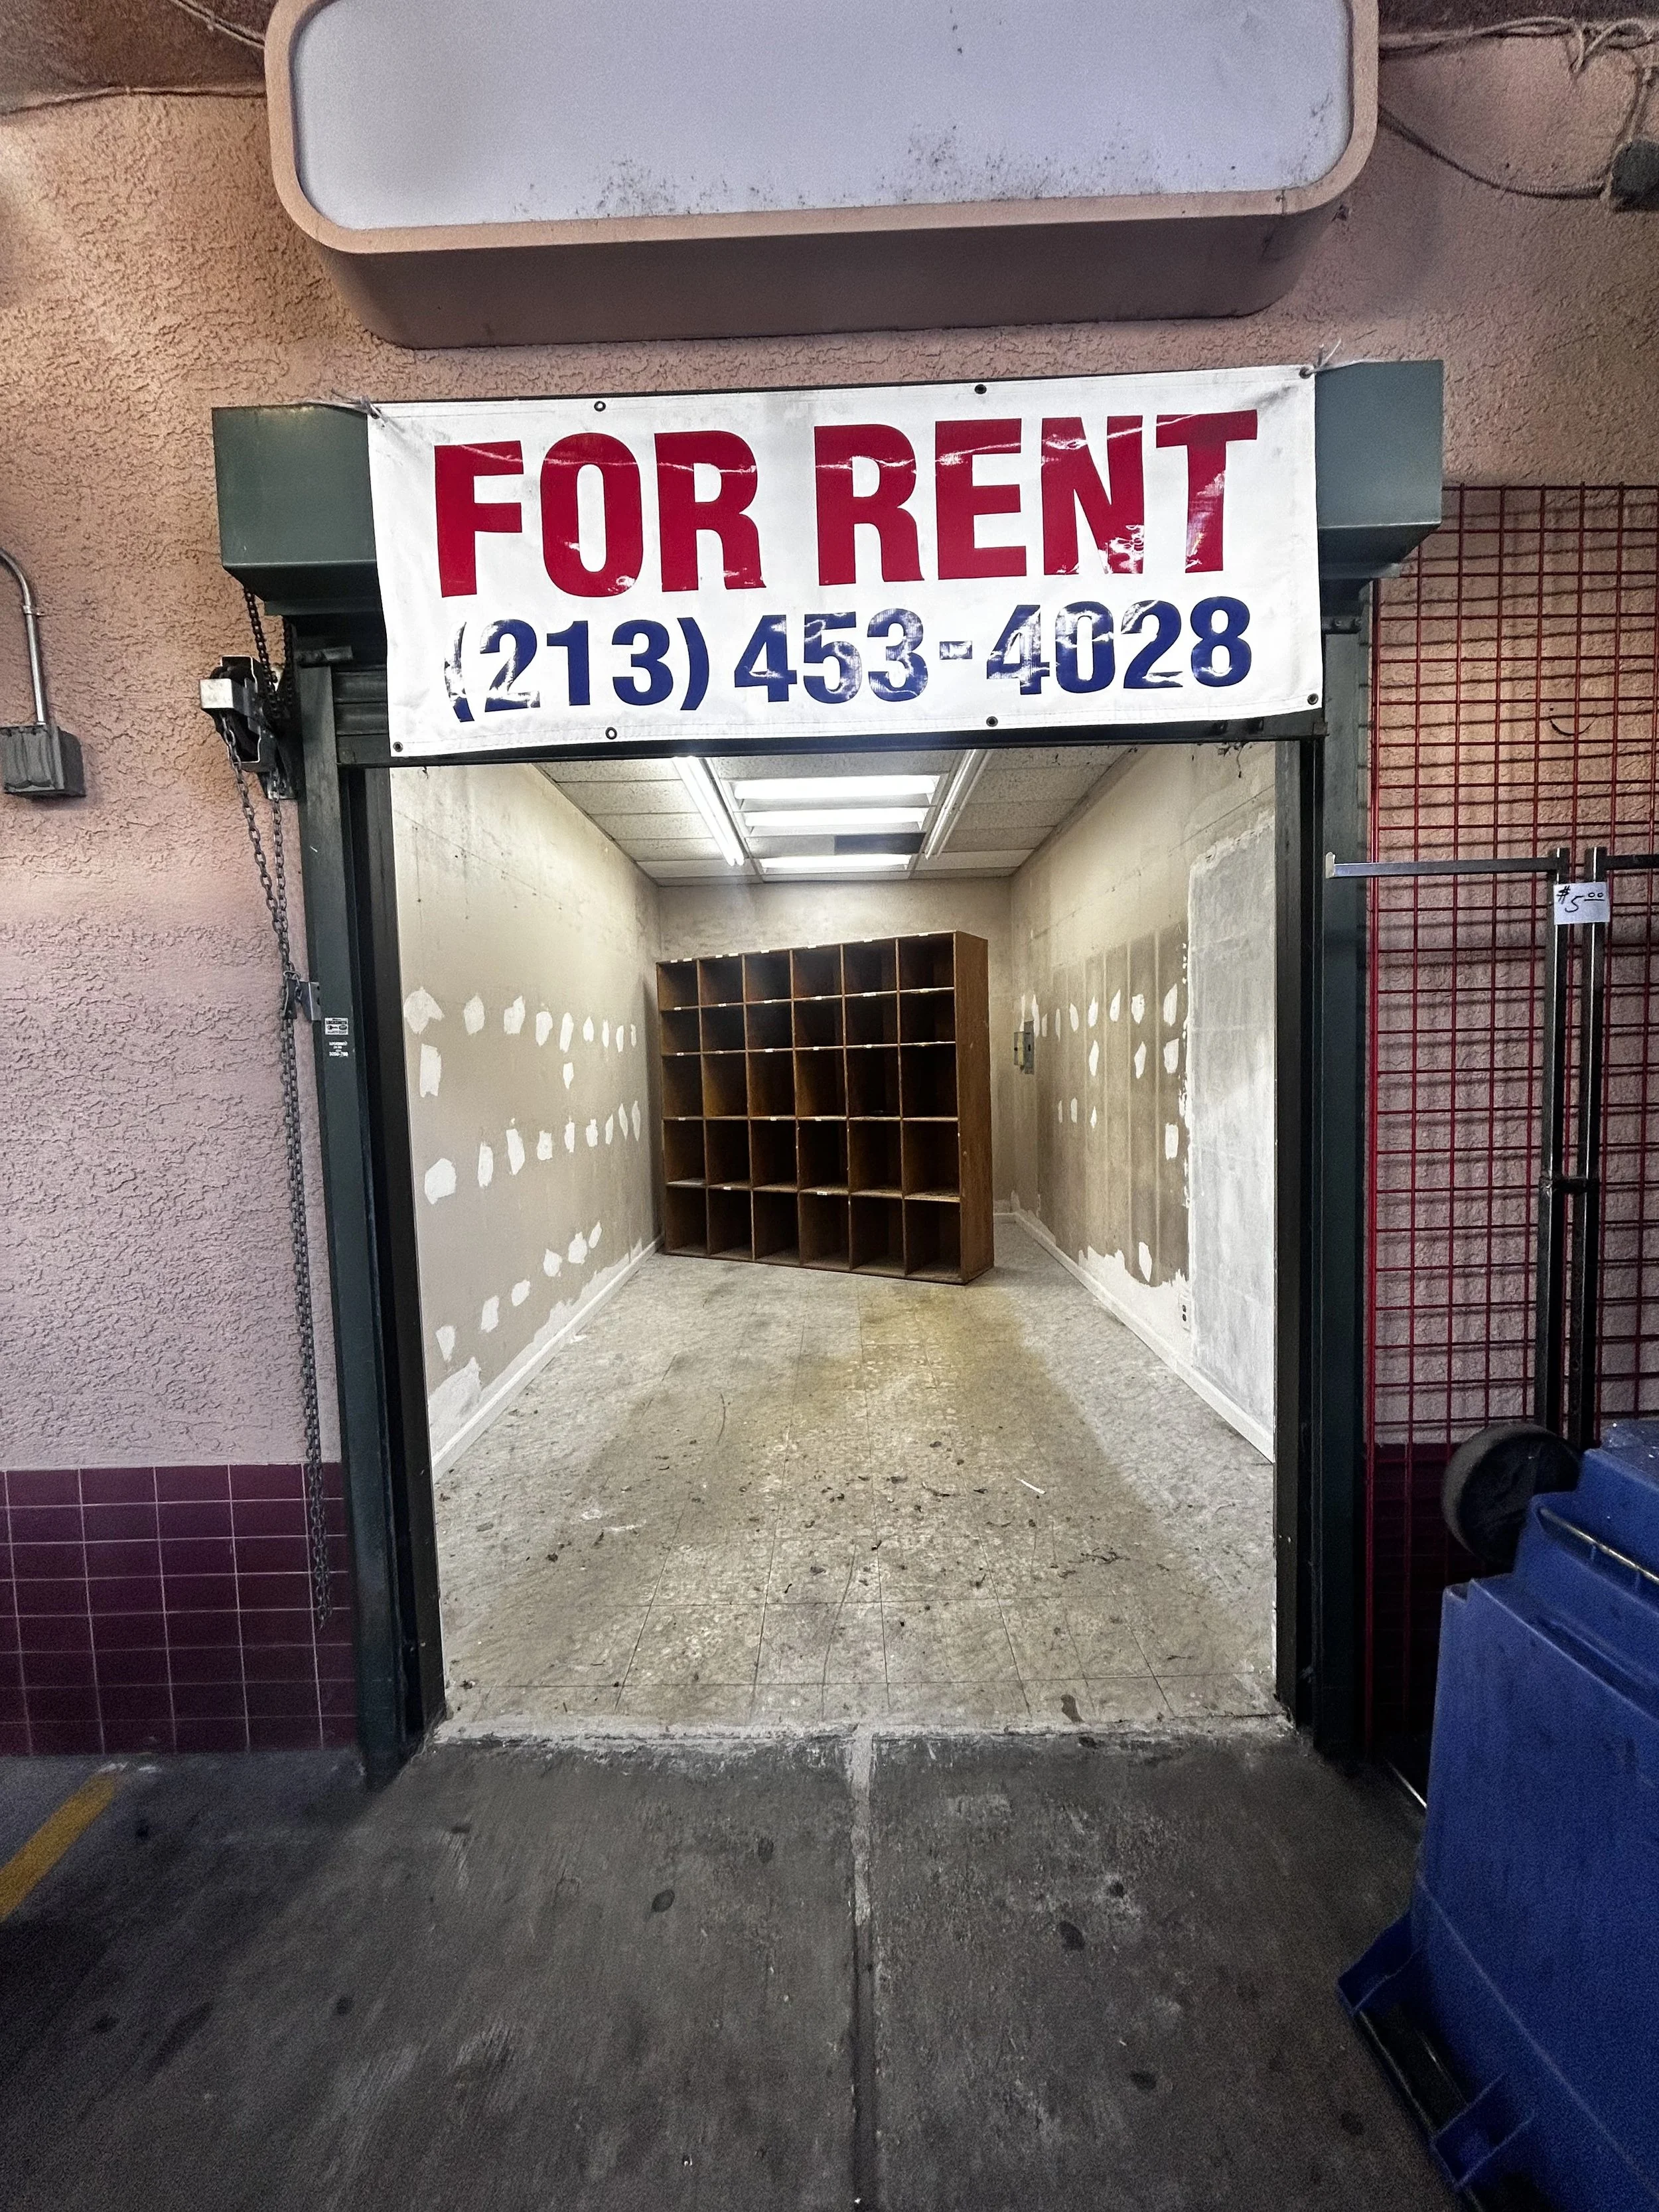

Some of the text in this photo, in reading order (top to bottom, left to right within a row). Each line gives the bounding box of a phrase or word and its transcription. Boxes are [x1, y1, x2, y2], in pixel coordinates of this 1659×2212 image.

[434, 409, 1258, 597] FOR RENT
[444, 596, 1252, 722] (213) 453-4028
